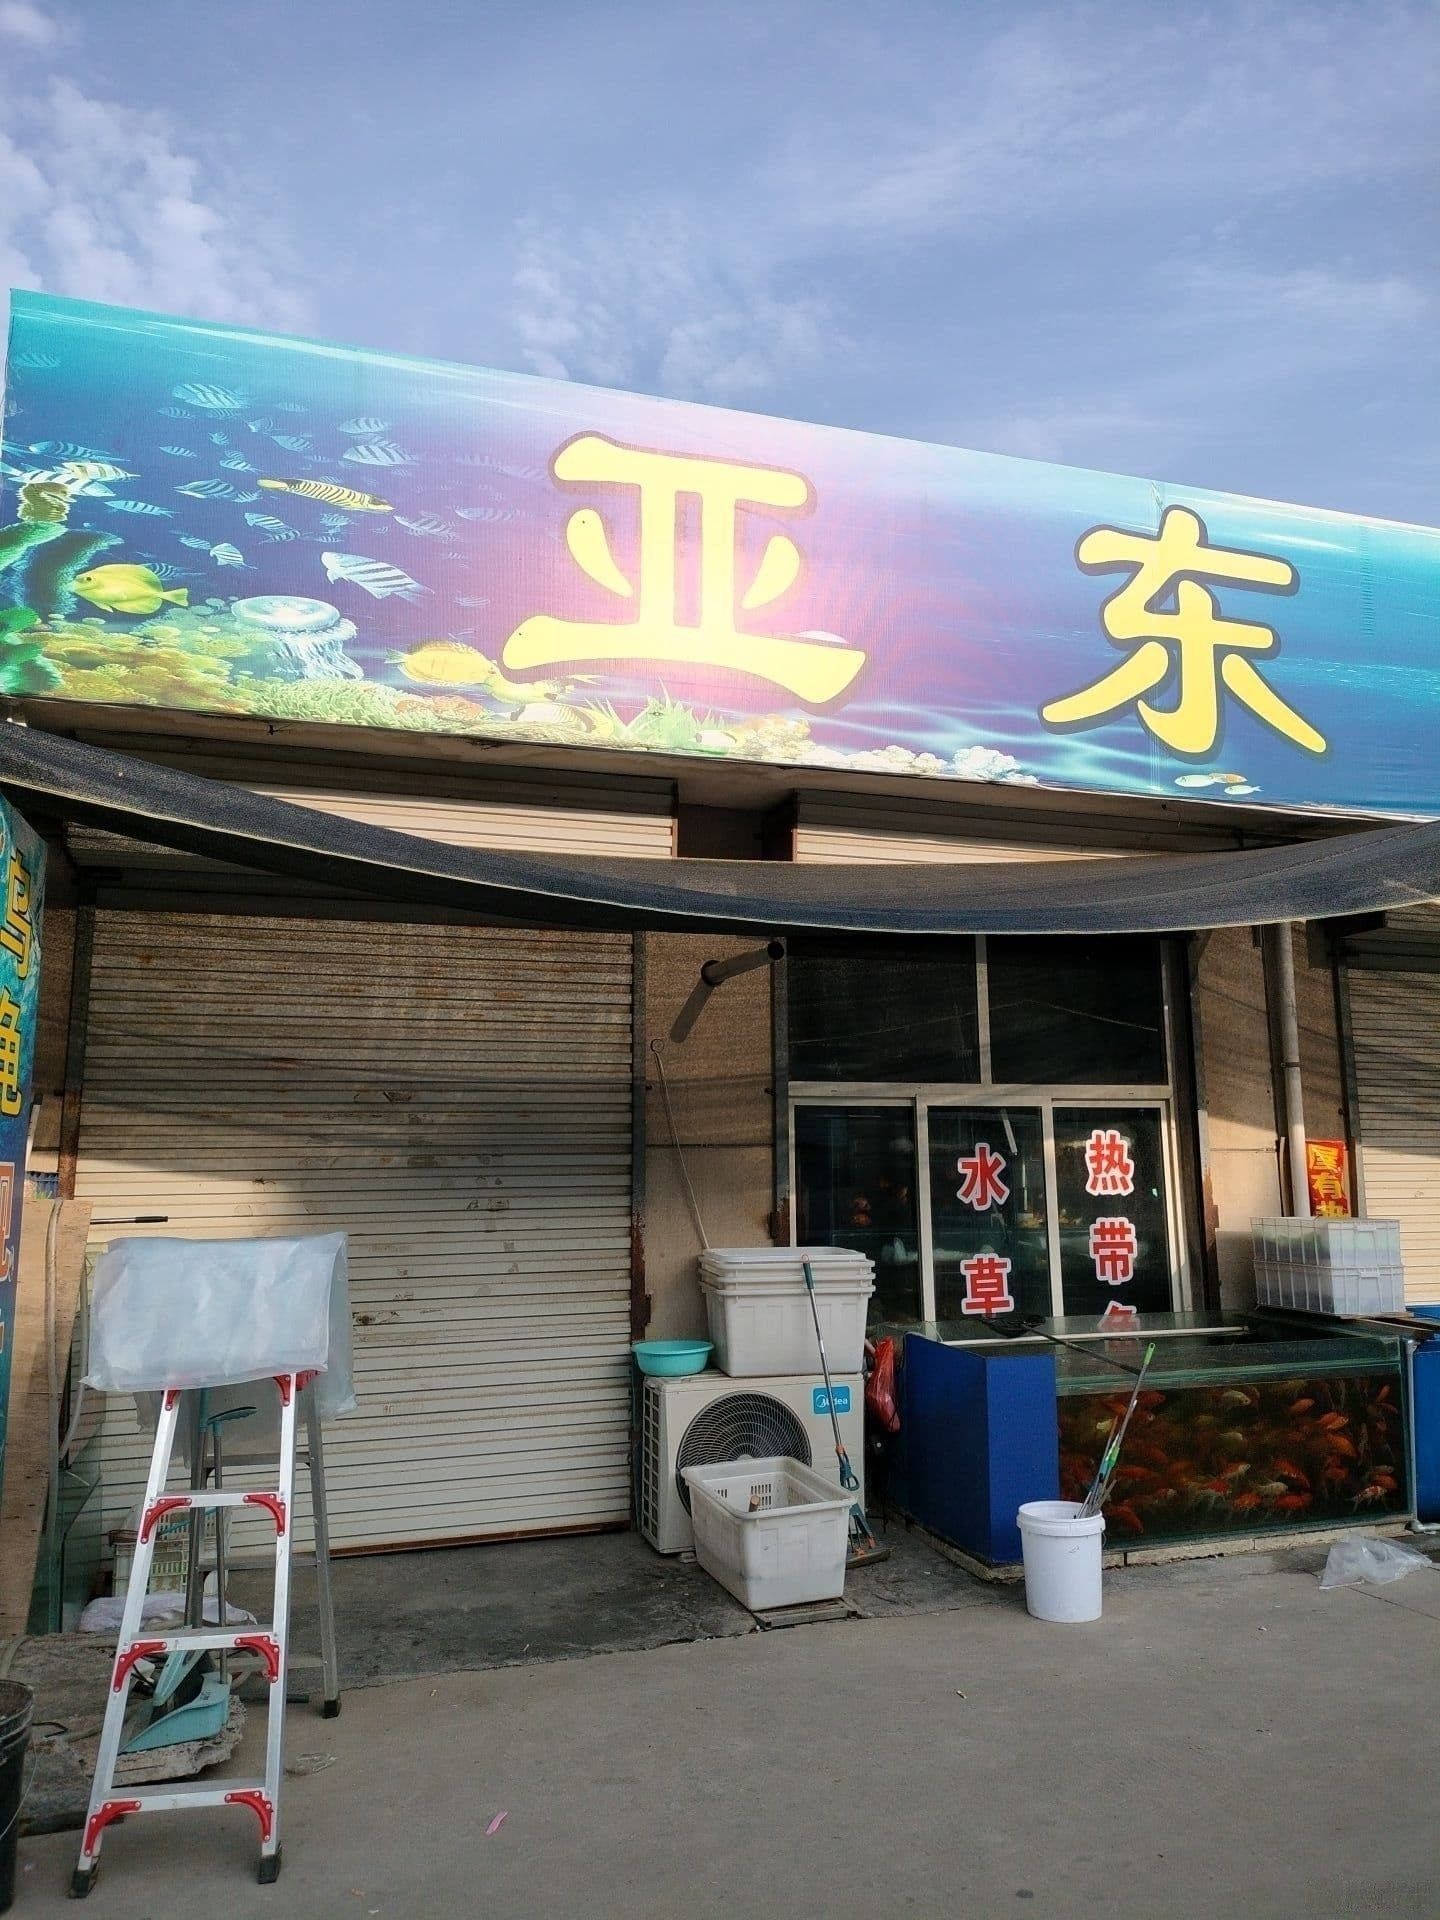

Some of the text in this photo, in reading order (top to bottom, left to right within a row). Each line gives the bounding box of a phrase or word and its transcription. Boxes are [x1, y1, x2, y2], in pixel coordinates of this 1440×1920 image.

[502, 434, 1328, 754] 亚东
[957, 1143, 1014, 1319] 水草
[815, 1393, 849, 1409] Mdea
